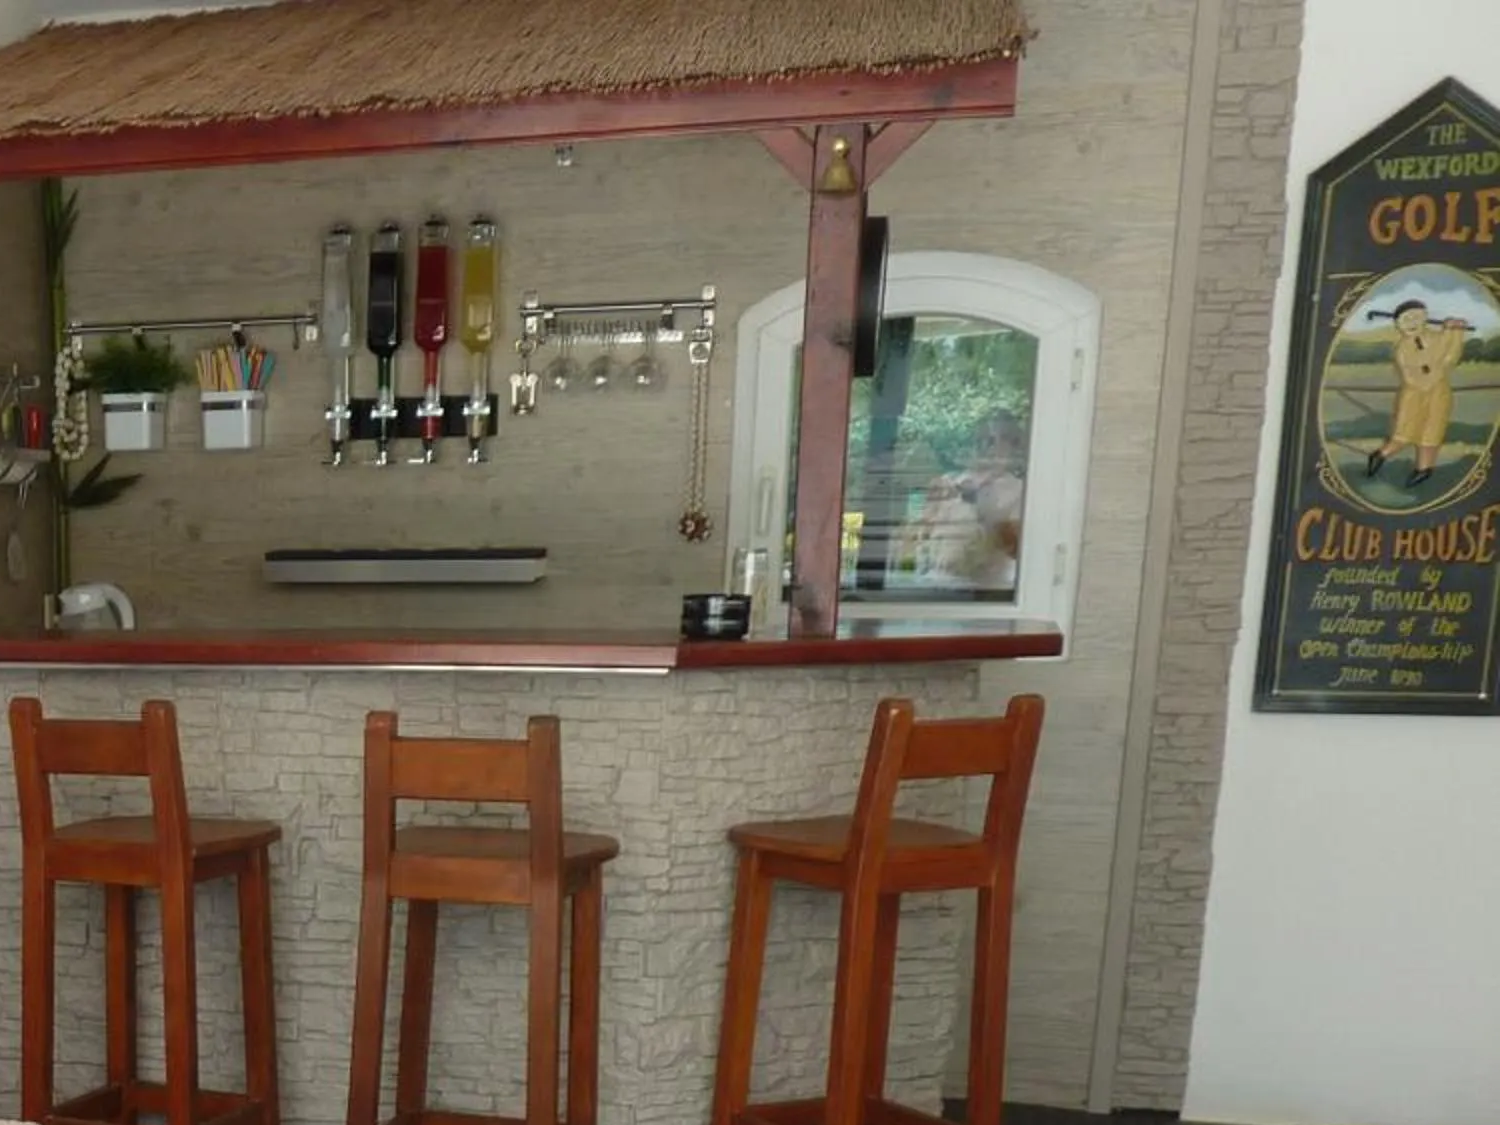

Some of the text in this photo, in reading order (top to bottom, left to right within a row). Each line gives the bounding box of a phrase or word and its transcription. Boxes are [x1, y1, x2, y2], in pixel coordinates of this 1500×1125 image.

[1426, 122, 1468, 146] THE
[1374, 151, 1500, 180] WEXFORD
[1369, 187, 1500, 245] GOLF
[1296, 503, 1500, 563] CLUB HOUSE
[1420, 564, 1443, 590] by
[1310, 590, 1473, 616] Henry ROWLAND
[1398, 617, 1416, 637] of
[1430, 615, 1461, 636] the
